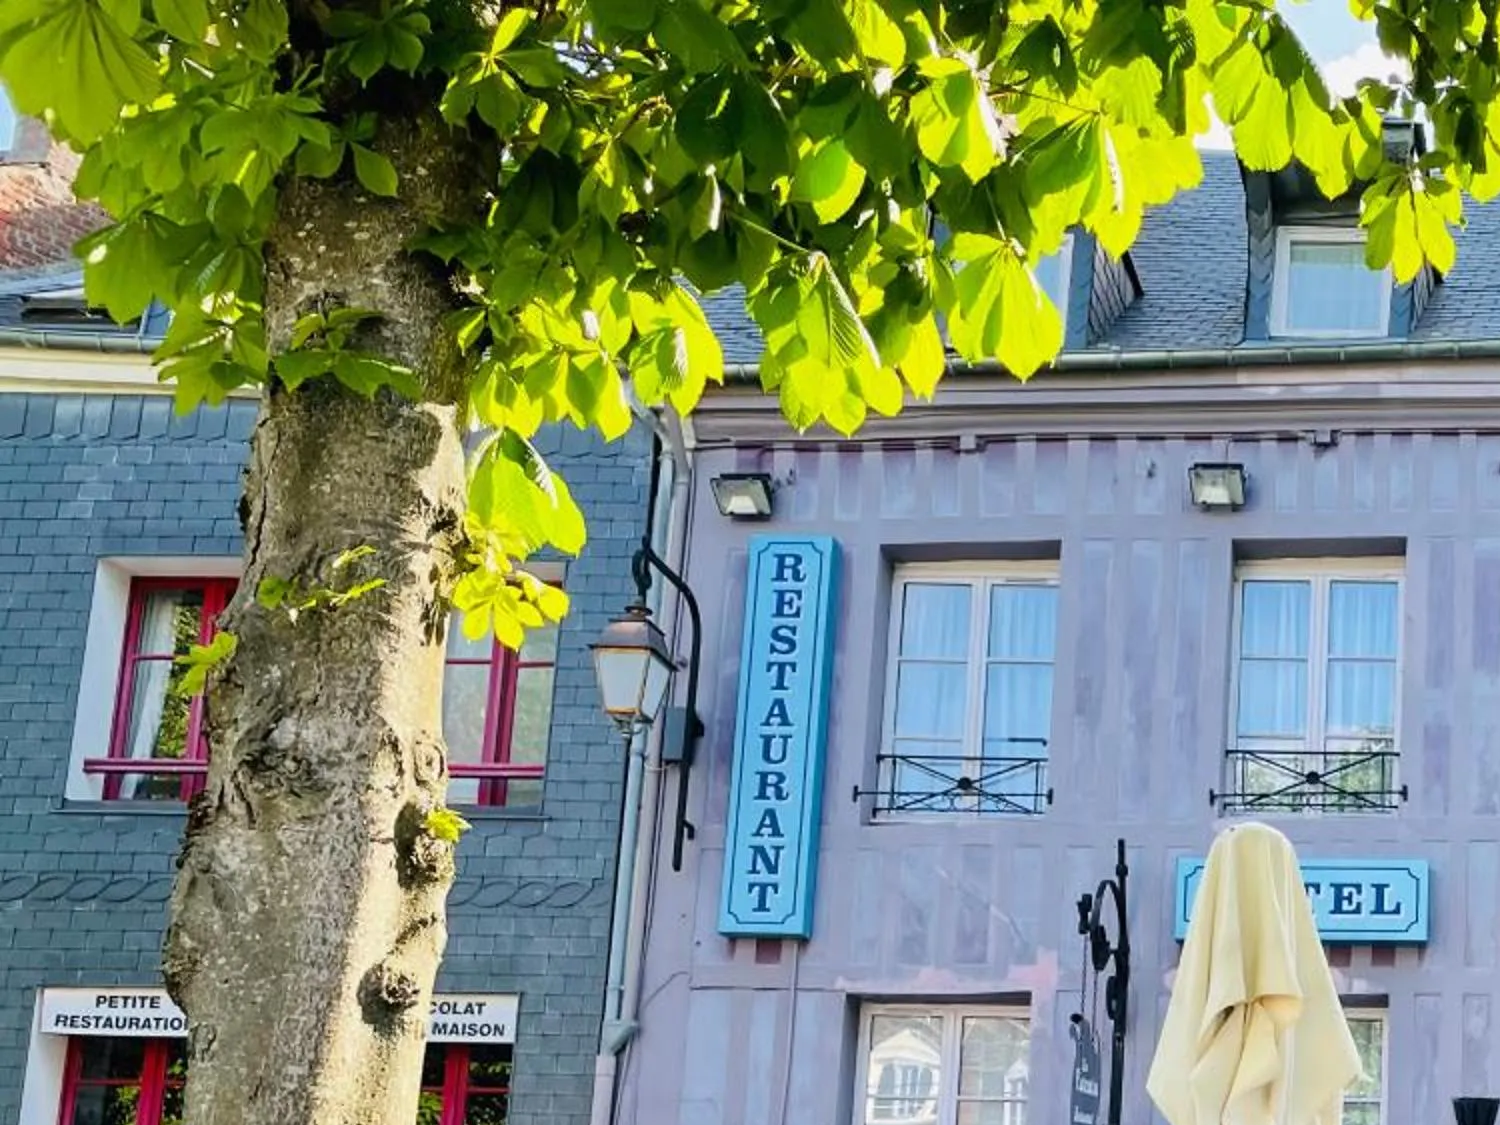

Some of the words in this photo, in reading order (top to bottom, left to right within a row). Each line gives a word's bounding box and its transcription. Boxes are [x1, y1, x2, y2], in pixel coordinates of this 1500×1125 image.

[747, 552, 807, 913] RESTAURANT
[95, 995, 161, 1009] PETITE
[431, 1022, 505, 1037] MAISON
